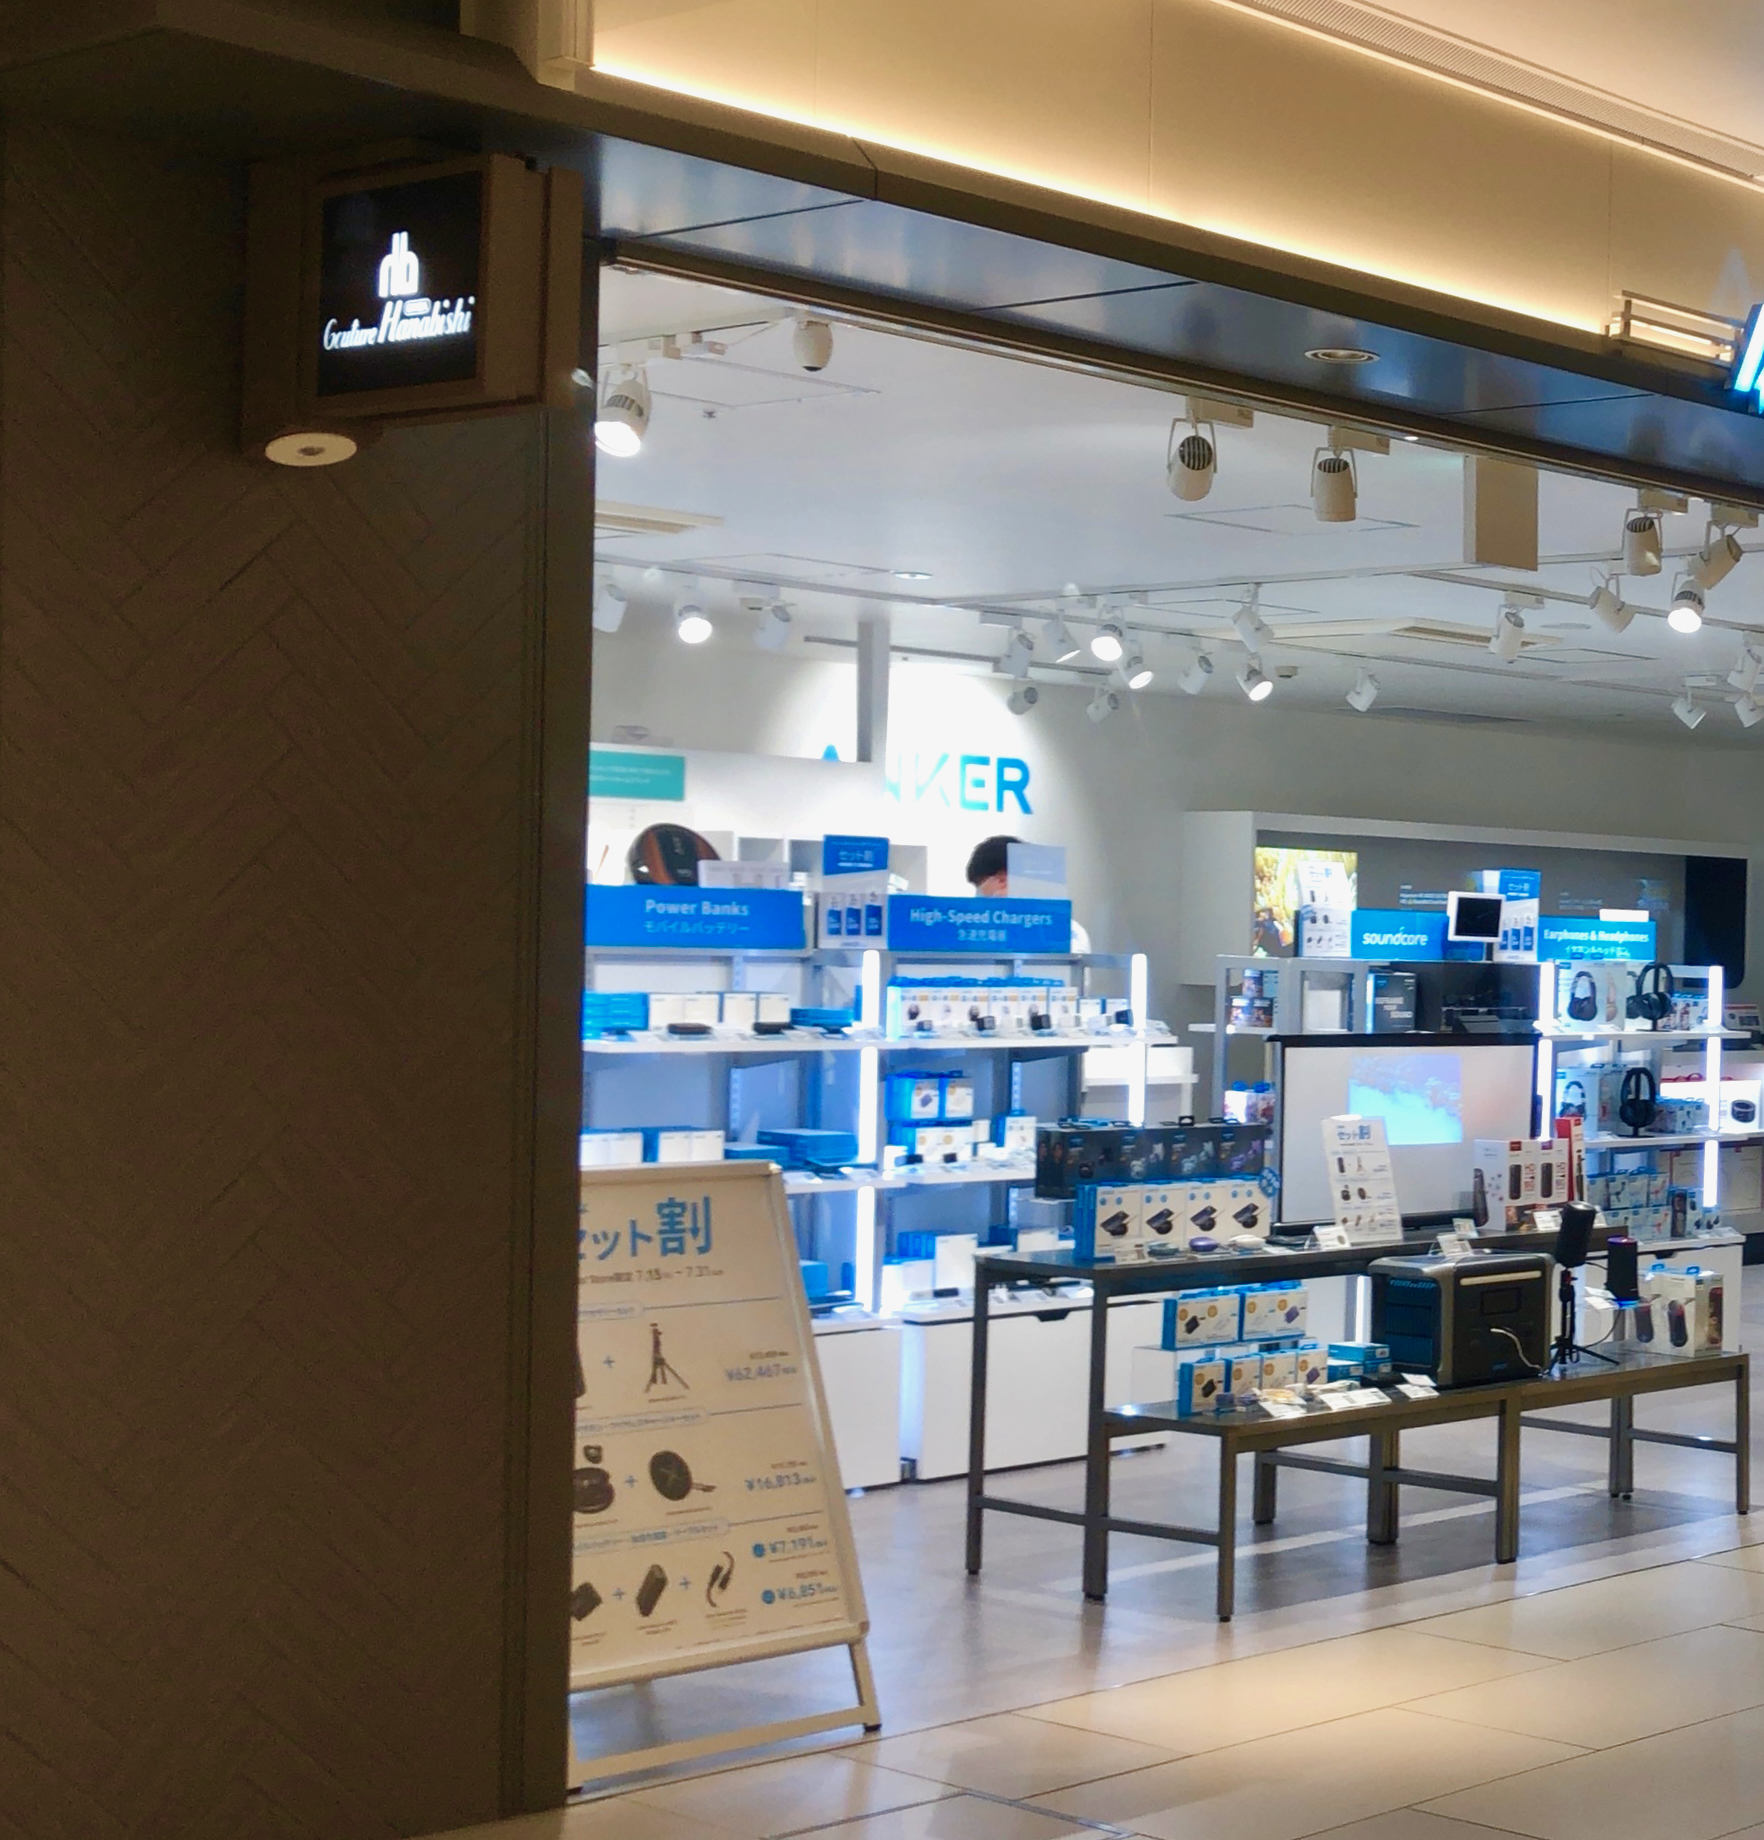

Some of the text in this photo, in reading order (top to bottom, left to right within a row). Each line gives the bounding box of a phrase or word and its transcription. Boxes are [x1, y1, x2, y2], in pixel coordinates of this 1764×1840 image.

[377, 296, 475, 344] Hanabishi
[645, 899, 749, 916] Power Banks
[909, 908, 1053, 928] High-Speed Chargers
[1362, 927, 1428, 946] soundcore
[1543, 928, 1589, 942] Earphones
[577, 1195, 713, 1260] ット割
